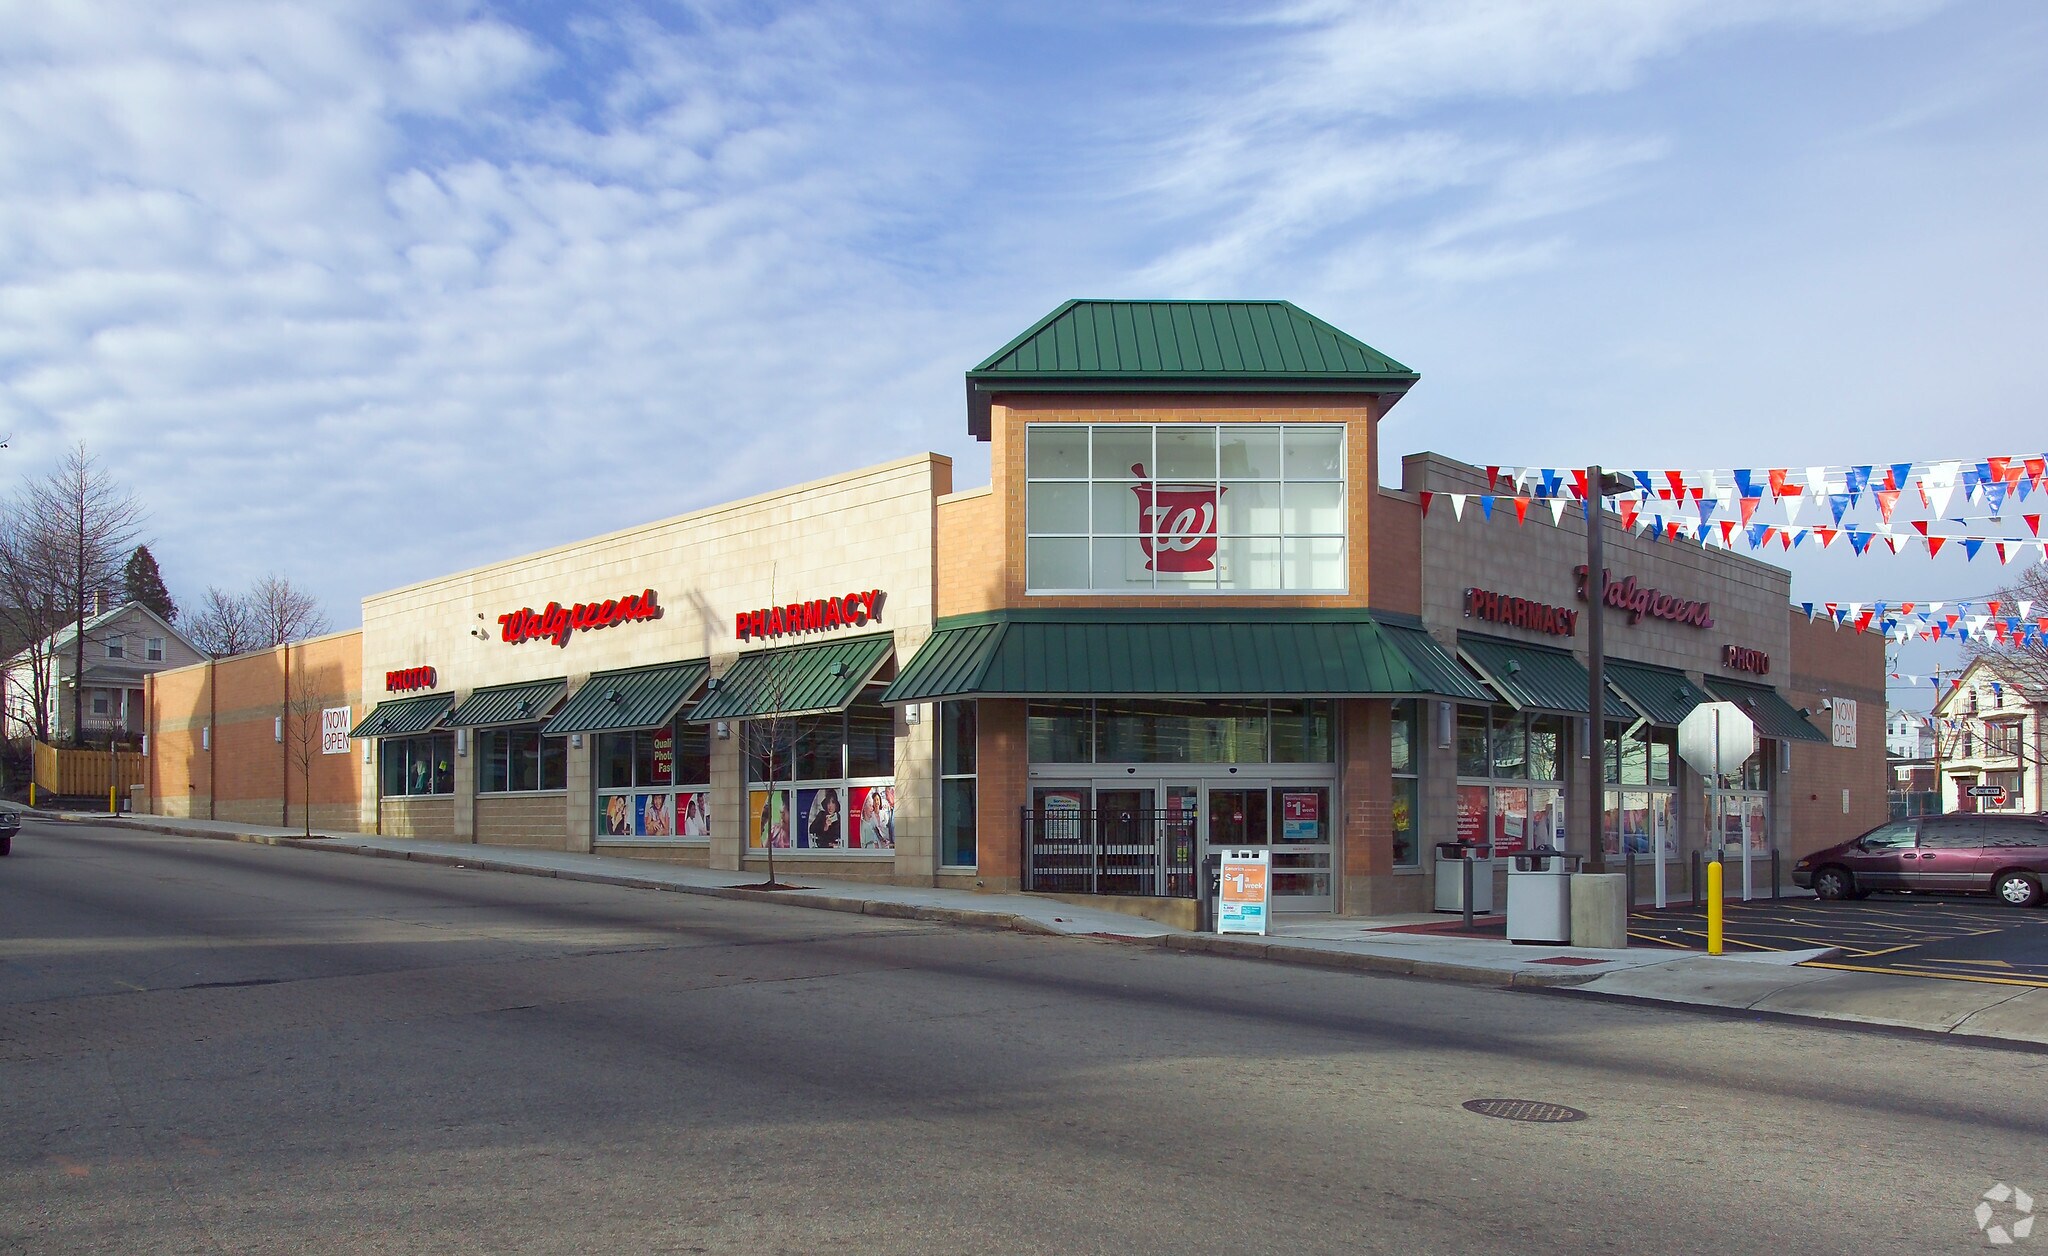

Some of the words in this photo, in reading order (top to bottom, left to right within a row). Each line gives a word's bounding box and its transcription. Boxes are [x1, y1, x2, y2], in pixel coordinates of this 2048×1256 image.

[1143, 502, 1214, 552] W
[499, 589, 658, 647] Walgreens
[736, 589, 880, 640] PHARMACY
[1469, 588, 1579, 637] PHARMACY
[1728, 645, 1770, 674] PHOTO
[386, 665, 433, 691] PHOTO
[326, 710, 348, 729] NOW
[1834, 702, 1855, 721] NOW
[324, 732, 350, 750] OPEN
[1834, 723, 1856, 743] OPEN
